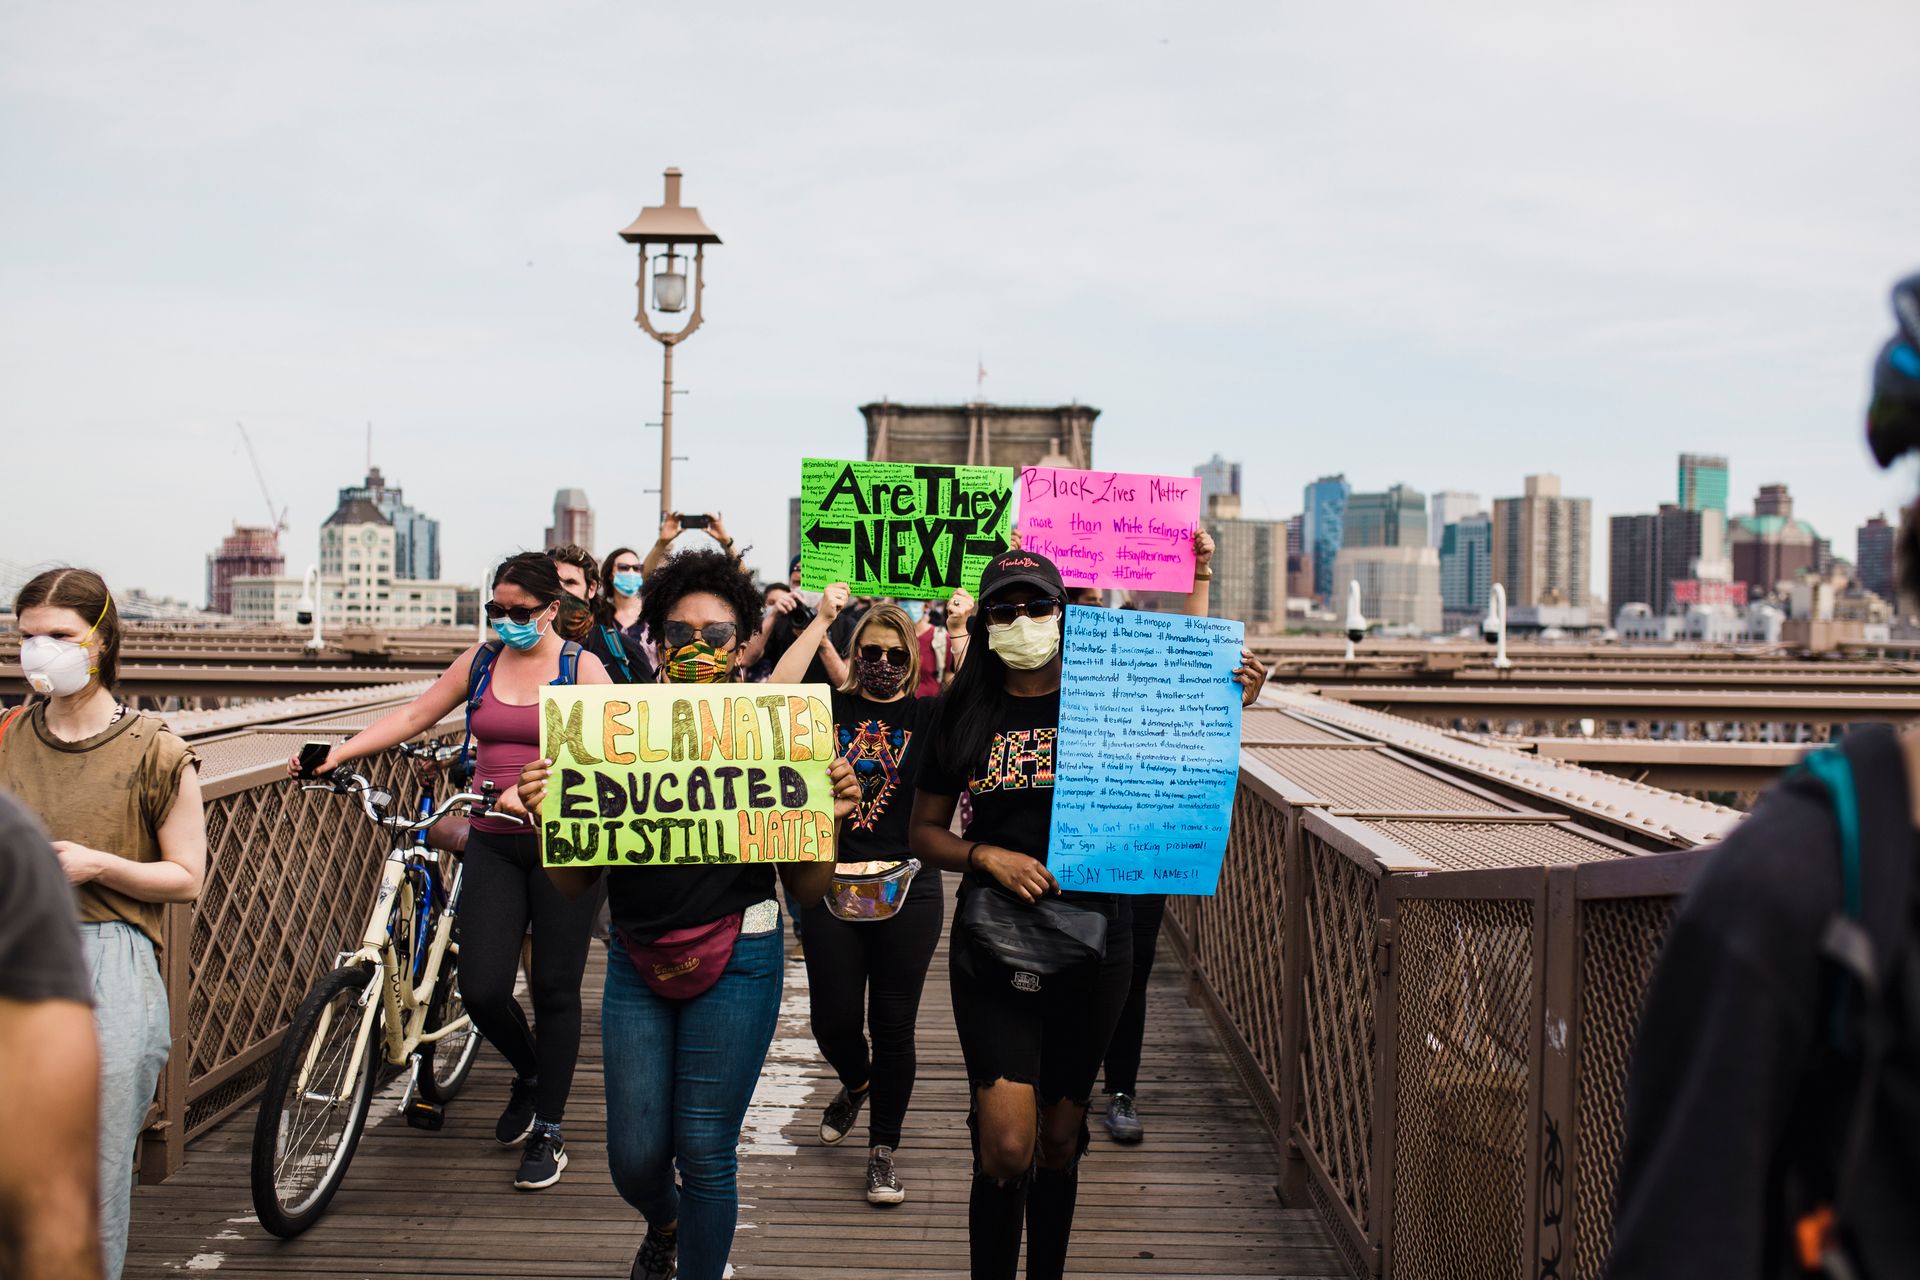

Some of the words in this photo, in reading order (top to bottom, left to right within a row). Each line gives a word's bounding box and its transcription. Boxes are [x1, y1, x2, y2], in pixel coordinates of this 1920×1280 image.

[819, 463, 917, 515] Are
[914, 466, 1012, 534] They
[1022, 468, 1094, 503] Black
[1092, 473, 1136, 504] Lives
[1150, 479, 1188, 504] Matter
[1029, 517, 1053, 529] more
[1070, 513, 1101, 533] than
[854, 517, 978, 588] NEXT
[545, 694, 834, 767] MELANATED
[560, 766, 808, 818] EDUCATED
[545, 819, 625, 864] BUT
[625, 818, 738, 864] STILL
[737, 809, 834, 863] HATED
[1057, 821, 1079, 834] When
[1162, 821, 1176, 831] the
[1058, 864, 1101, 885] #SAY
[1106, 867, 1145, 883] THEIR
[1153, 868, 1199, 880] NAMES!!
